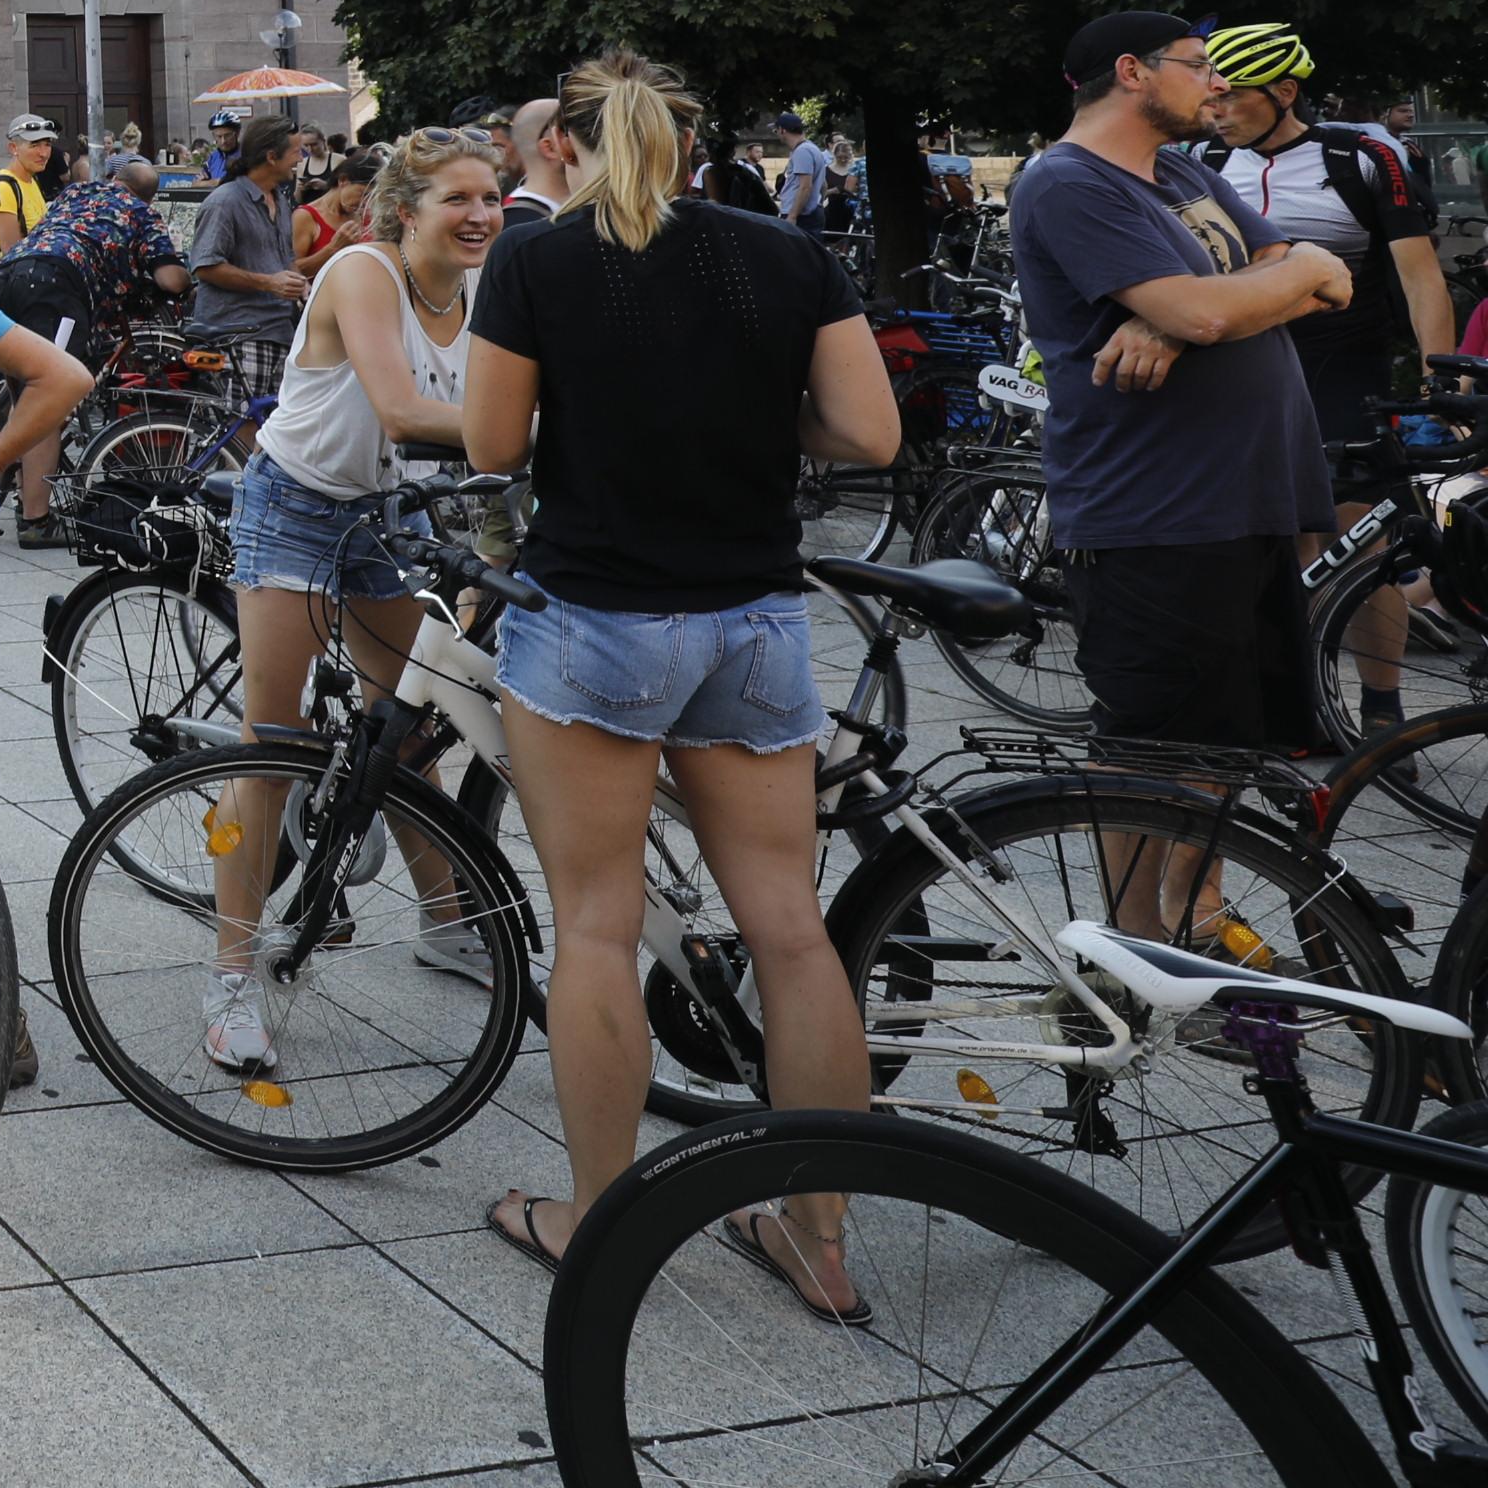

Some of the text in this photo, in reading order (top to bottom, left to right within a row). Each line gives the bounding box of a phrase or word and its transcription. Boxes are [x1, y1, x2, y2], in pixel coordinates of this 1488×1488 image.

[989, 374, 1045, 398] VAG RA
[333, 832, 358, 886] REX
[958, 1045, 1027, 1053] www.prophete.de
[653, 1131, 751, 1175] CONTINENTAL
